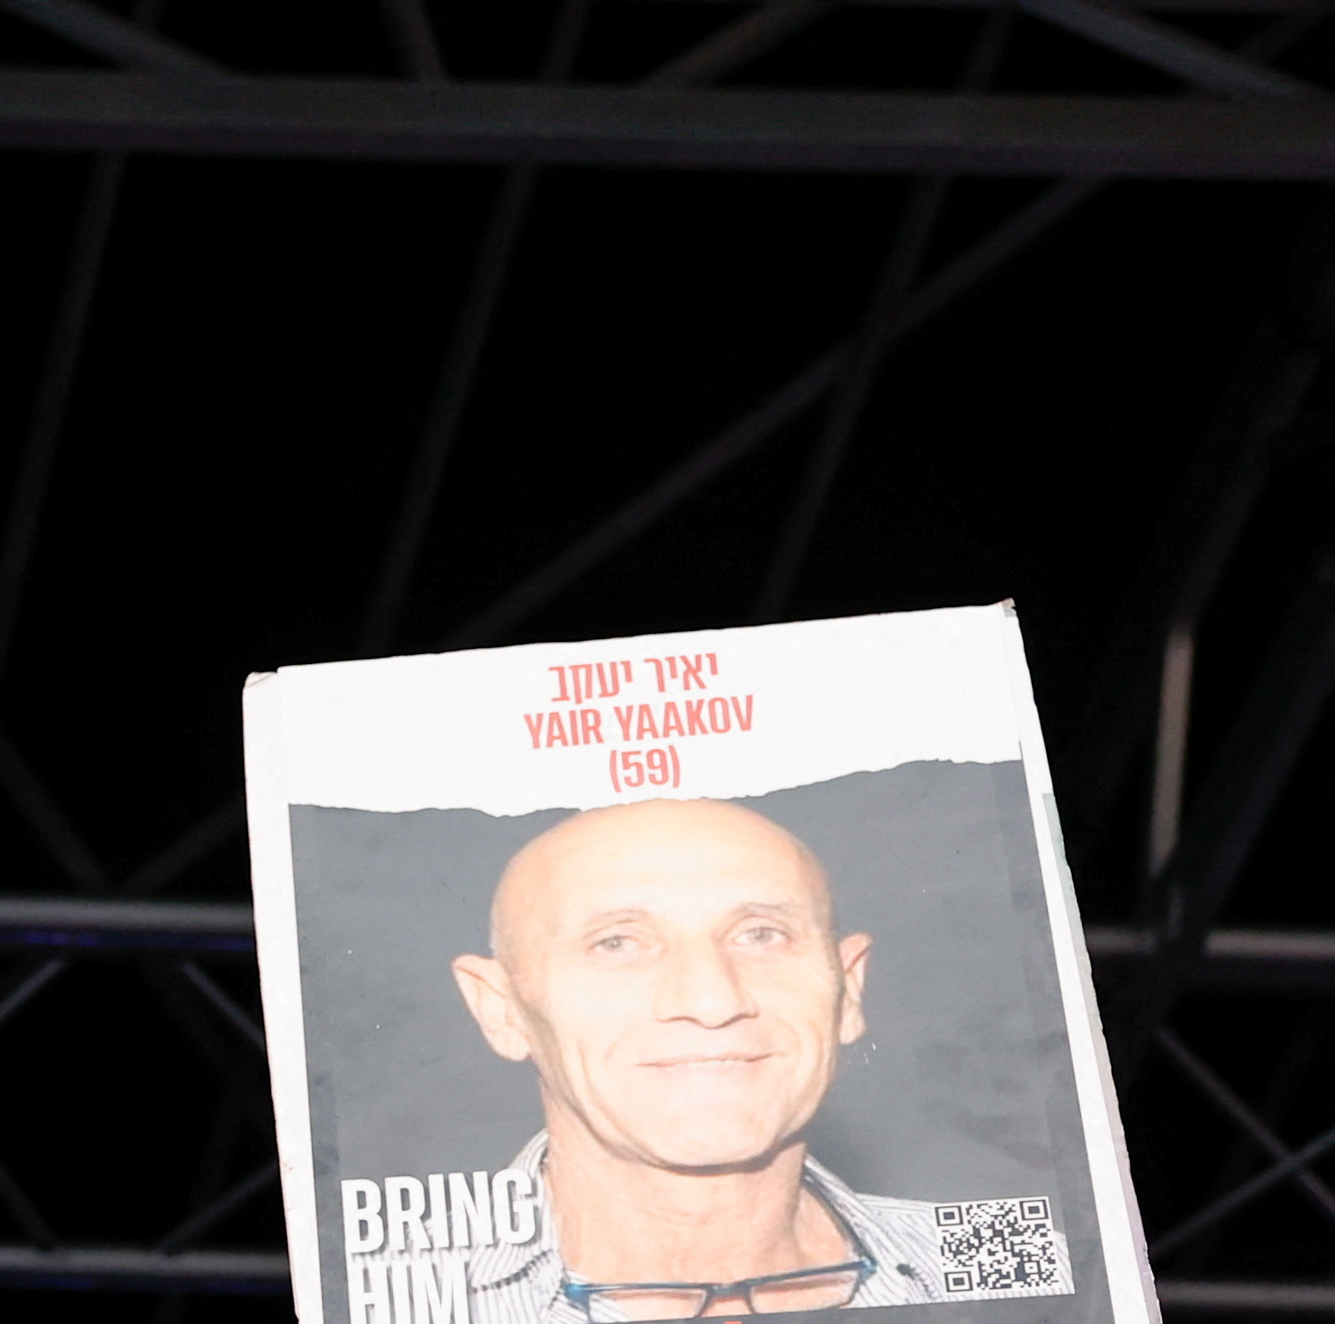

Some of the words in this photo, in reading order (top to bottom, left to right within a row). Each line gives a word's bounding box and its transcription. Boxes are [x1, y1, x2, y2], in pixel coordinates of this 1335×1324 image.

[547, 660, 633, 705] יעקב
[643, 652, 719, 693] יאיר
[523, 708, 604, 750] YAIR
[612, 694, 754, 742] YAAKOV
[609, 744, 681, 793] (59)
[340, 1168, 536, 1255] BRING
